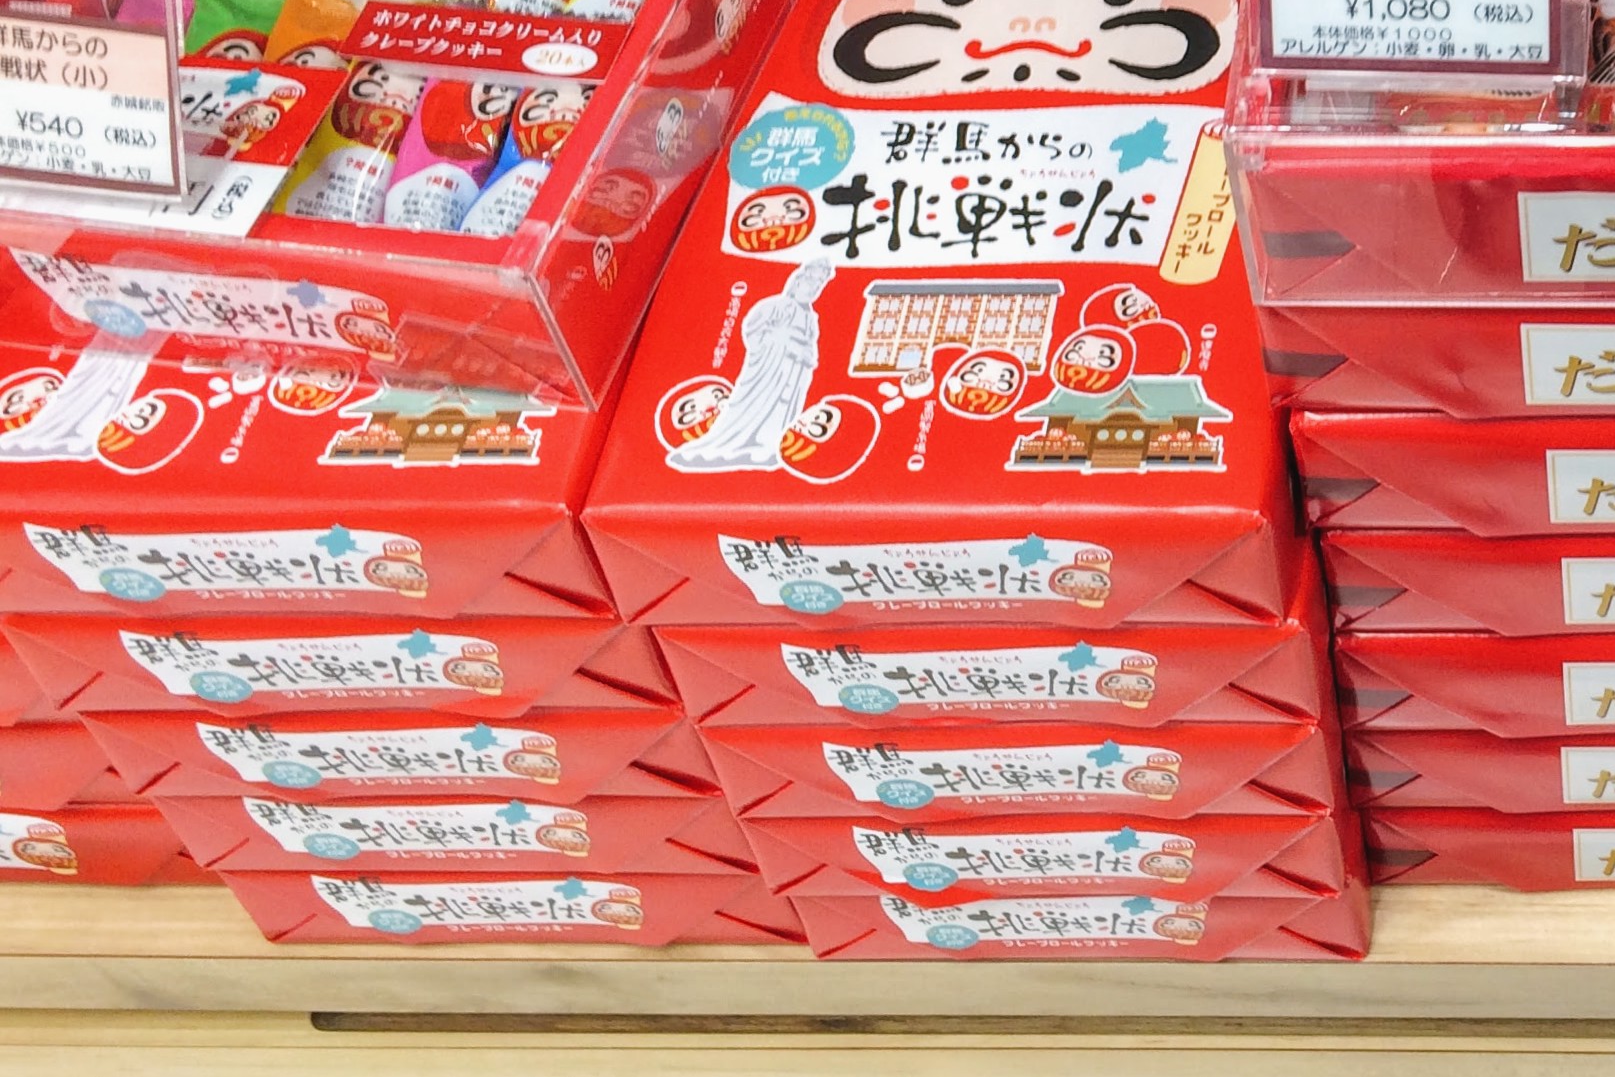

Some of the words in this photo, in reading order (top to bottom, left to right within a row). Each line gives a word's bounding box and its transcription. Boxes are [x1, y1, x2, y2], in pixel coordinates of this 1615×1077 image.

[374, 10, 602, 46] ホワイトチョコクリーム入り
[1473, 3, 1533, 23] （税込）
[361, 32, 503, 59] クレープクッキー
[16, 110, 83, 138] ¥540
[750, 147, 825, 166] クイズ
[882, 120, 1093, 165] 群馬からの
[762, 167, 800, 183] 付き
[820, 174, 1156, 259] 挑戦状
[138, 549, 360, 585] 挑戦状
[826, 560, 1041, 595] 挑戦状
[229, 653, 435, 686] 挑戦状
[883, 666, 1088, 699] 挑戦状
[920, 762, 1116, 793] 挑戦状
[945, 848, 1133, 874] 挑戦状
[967, 910, 1146, 936] 挑戦状
